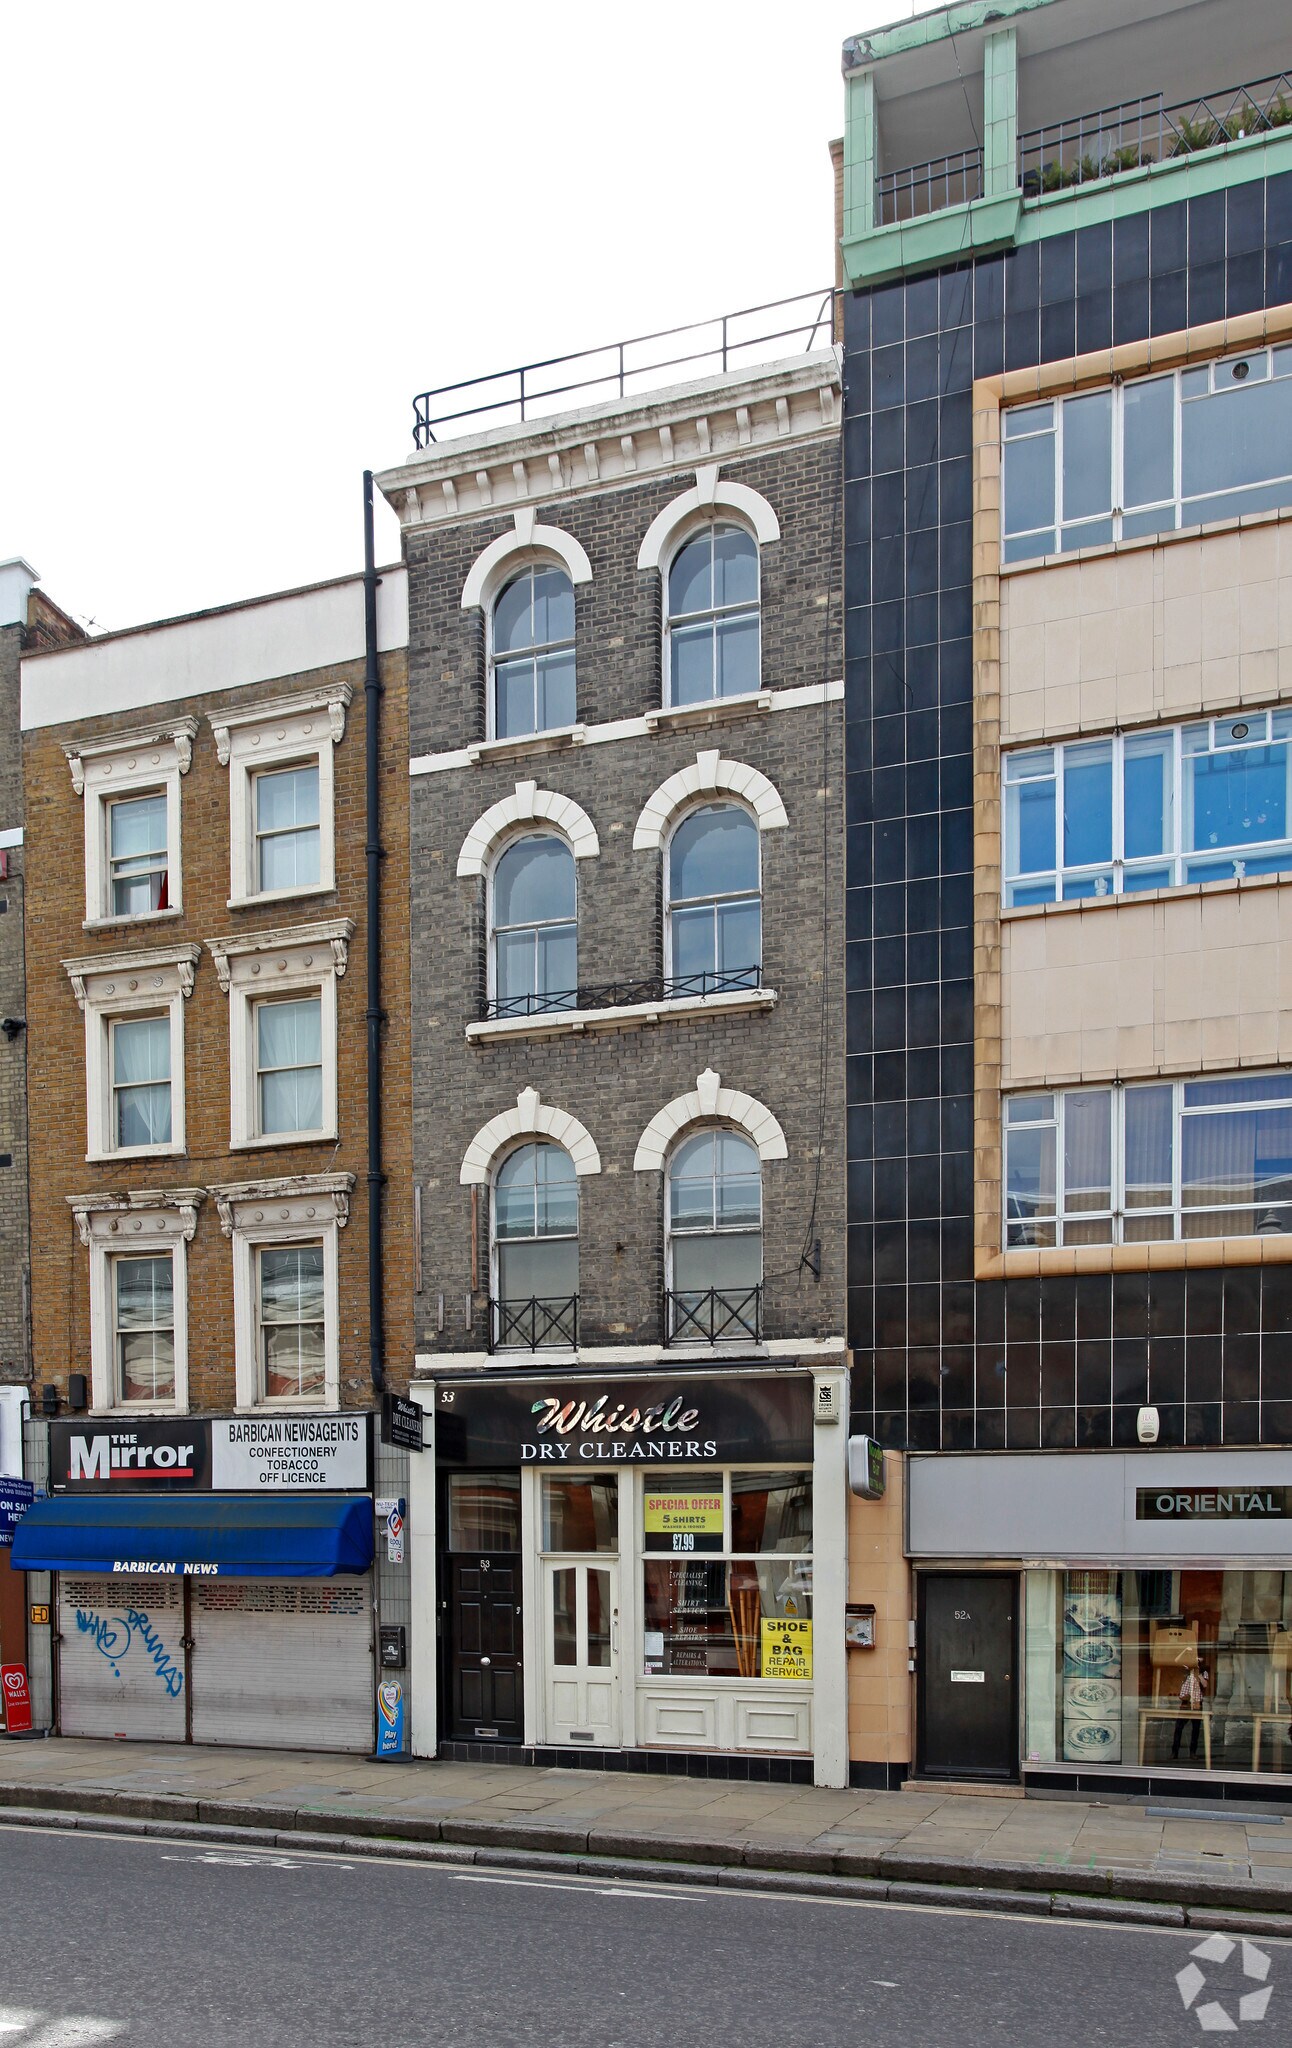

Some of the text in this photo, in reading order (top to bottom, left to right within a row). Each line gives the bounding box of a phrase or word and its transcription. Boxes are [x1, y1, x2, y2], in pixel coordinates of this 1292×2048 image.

[442, 1391, 455, 1403] 53
[531, 1394, 699, 1435] Whistle
[229, 1422, 359, 1443] BARBICAN NEWSAGENTS
[111, 1434, 137, 1444] THE
[249, 1446, 337, 1458] CONFECTIONERY
[521, 1440, 717, 1459] DRY CLEANERS
[70, 1435, 193, 1480] Mirror
[267, 1459, 319, 1470] TOBACCO
[259, 1472, 326, 1483] OFF LICENCE
[0, 1501, 13, 1510] ON
[649, 1499, 721, 1510] SPECIAL OFFER
[1156, 1493, 1281, 1513] ORIENTAL
[663, 1514, 671, 1523] 5
[673, 1533, 695, 1551] £7.99
[113, 1561, 219, 1575] BARBICAN NEWS
[480, 1559, 490, 1568] 53
[672, 1571, 705, 1579] SPECIALIST
[674, 1579, 703, 1587] CLEANING
[679, 1626, 697, 1634] SHOE
[767, 1621, 808, 1632] SHOE
[782, 1634, 792, 1643] &
[676, 1651, 697, 1659] REPAIRS
[772, 1645, 803, 1655] BAG
[769, 1656, 806, 1666] REPAIR
[765, 1667, 810, 1677] SERVICE
[385, 1731, 397, 1739] Play
[382, 1740, 398, 1750] here!
